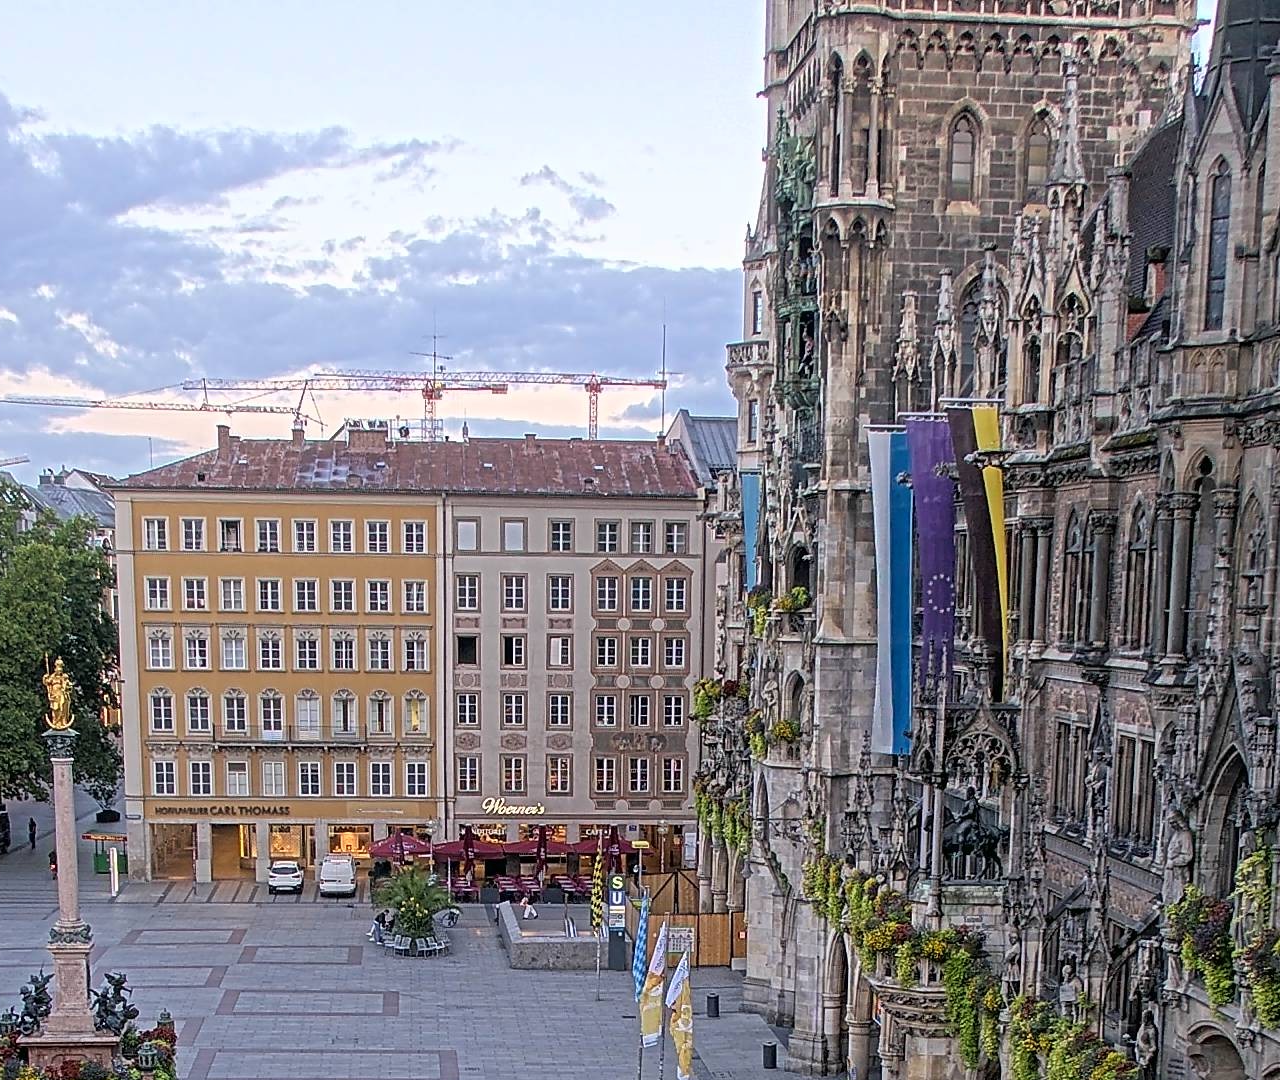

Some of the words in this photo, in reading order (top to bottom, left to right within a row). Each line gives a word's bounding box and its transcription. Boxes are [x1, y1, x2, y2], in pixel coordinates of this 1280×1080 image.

[210, 805, 237, 816] CARL
[238, 806, 290, 816] THOMASS
[482, 797, 545, 816] Woerner's
[611, 875, 624, 890] S
[611, 892, 623, 905] U
